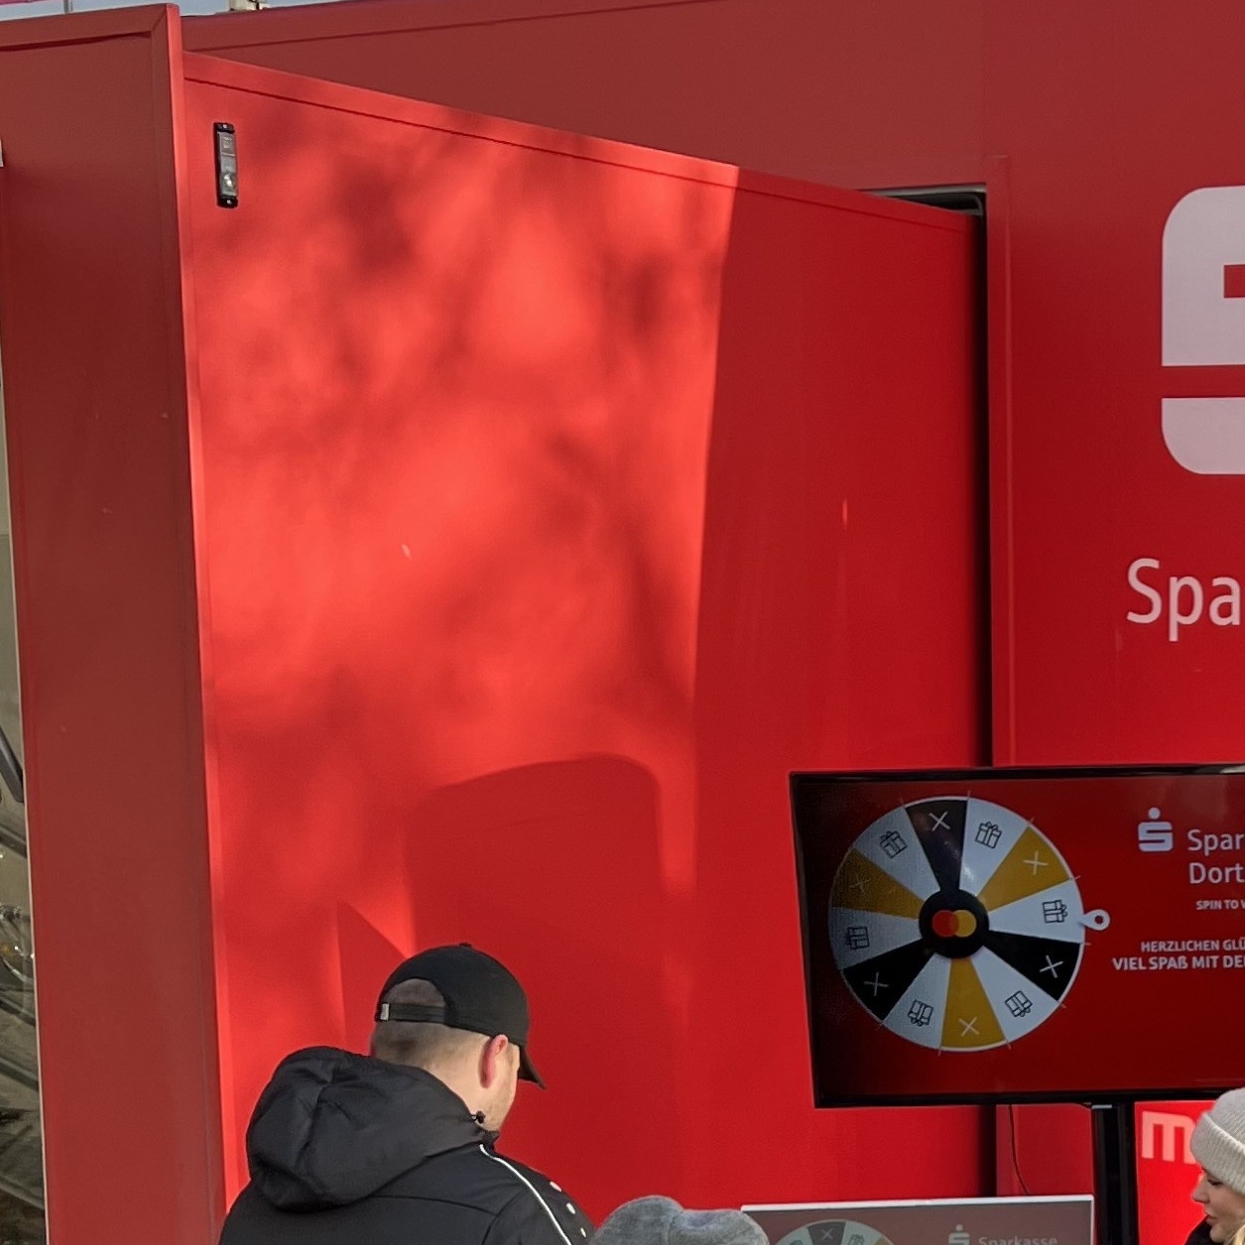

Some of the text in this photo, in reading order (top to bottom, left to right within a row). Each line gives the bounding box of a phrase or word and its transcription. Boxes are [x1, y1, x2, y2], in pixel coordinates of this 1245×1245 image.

[1196, 900, 1222, 910] SPIN
[1225, 899, 1238, 910] TO
[1141, 940, 1220, 952] HERZLICHEN
[1112, 957, 1146, 971] VIEL
[1192, 955, 1219, 968] MIT
